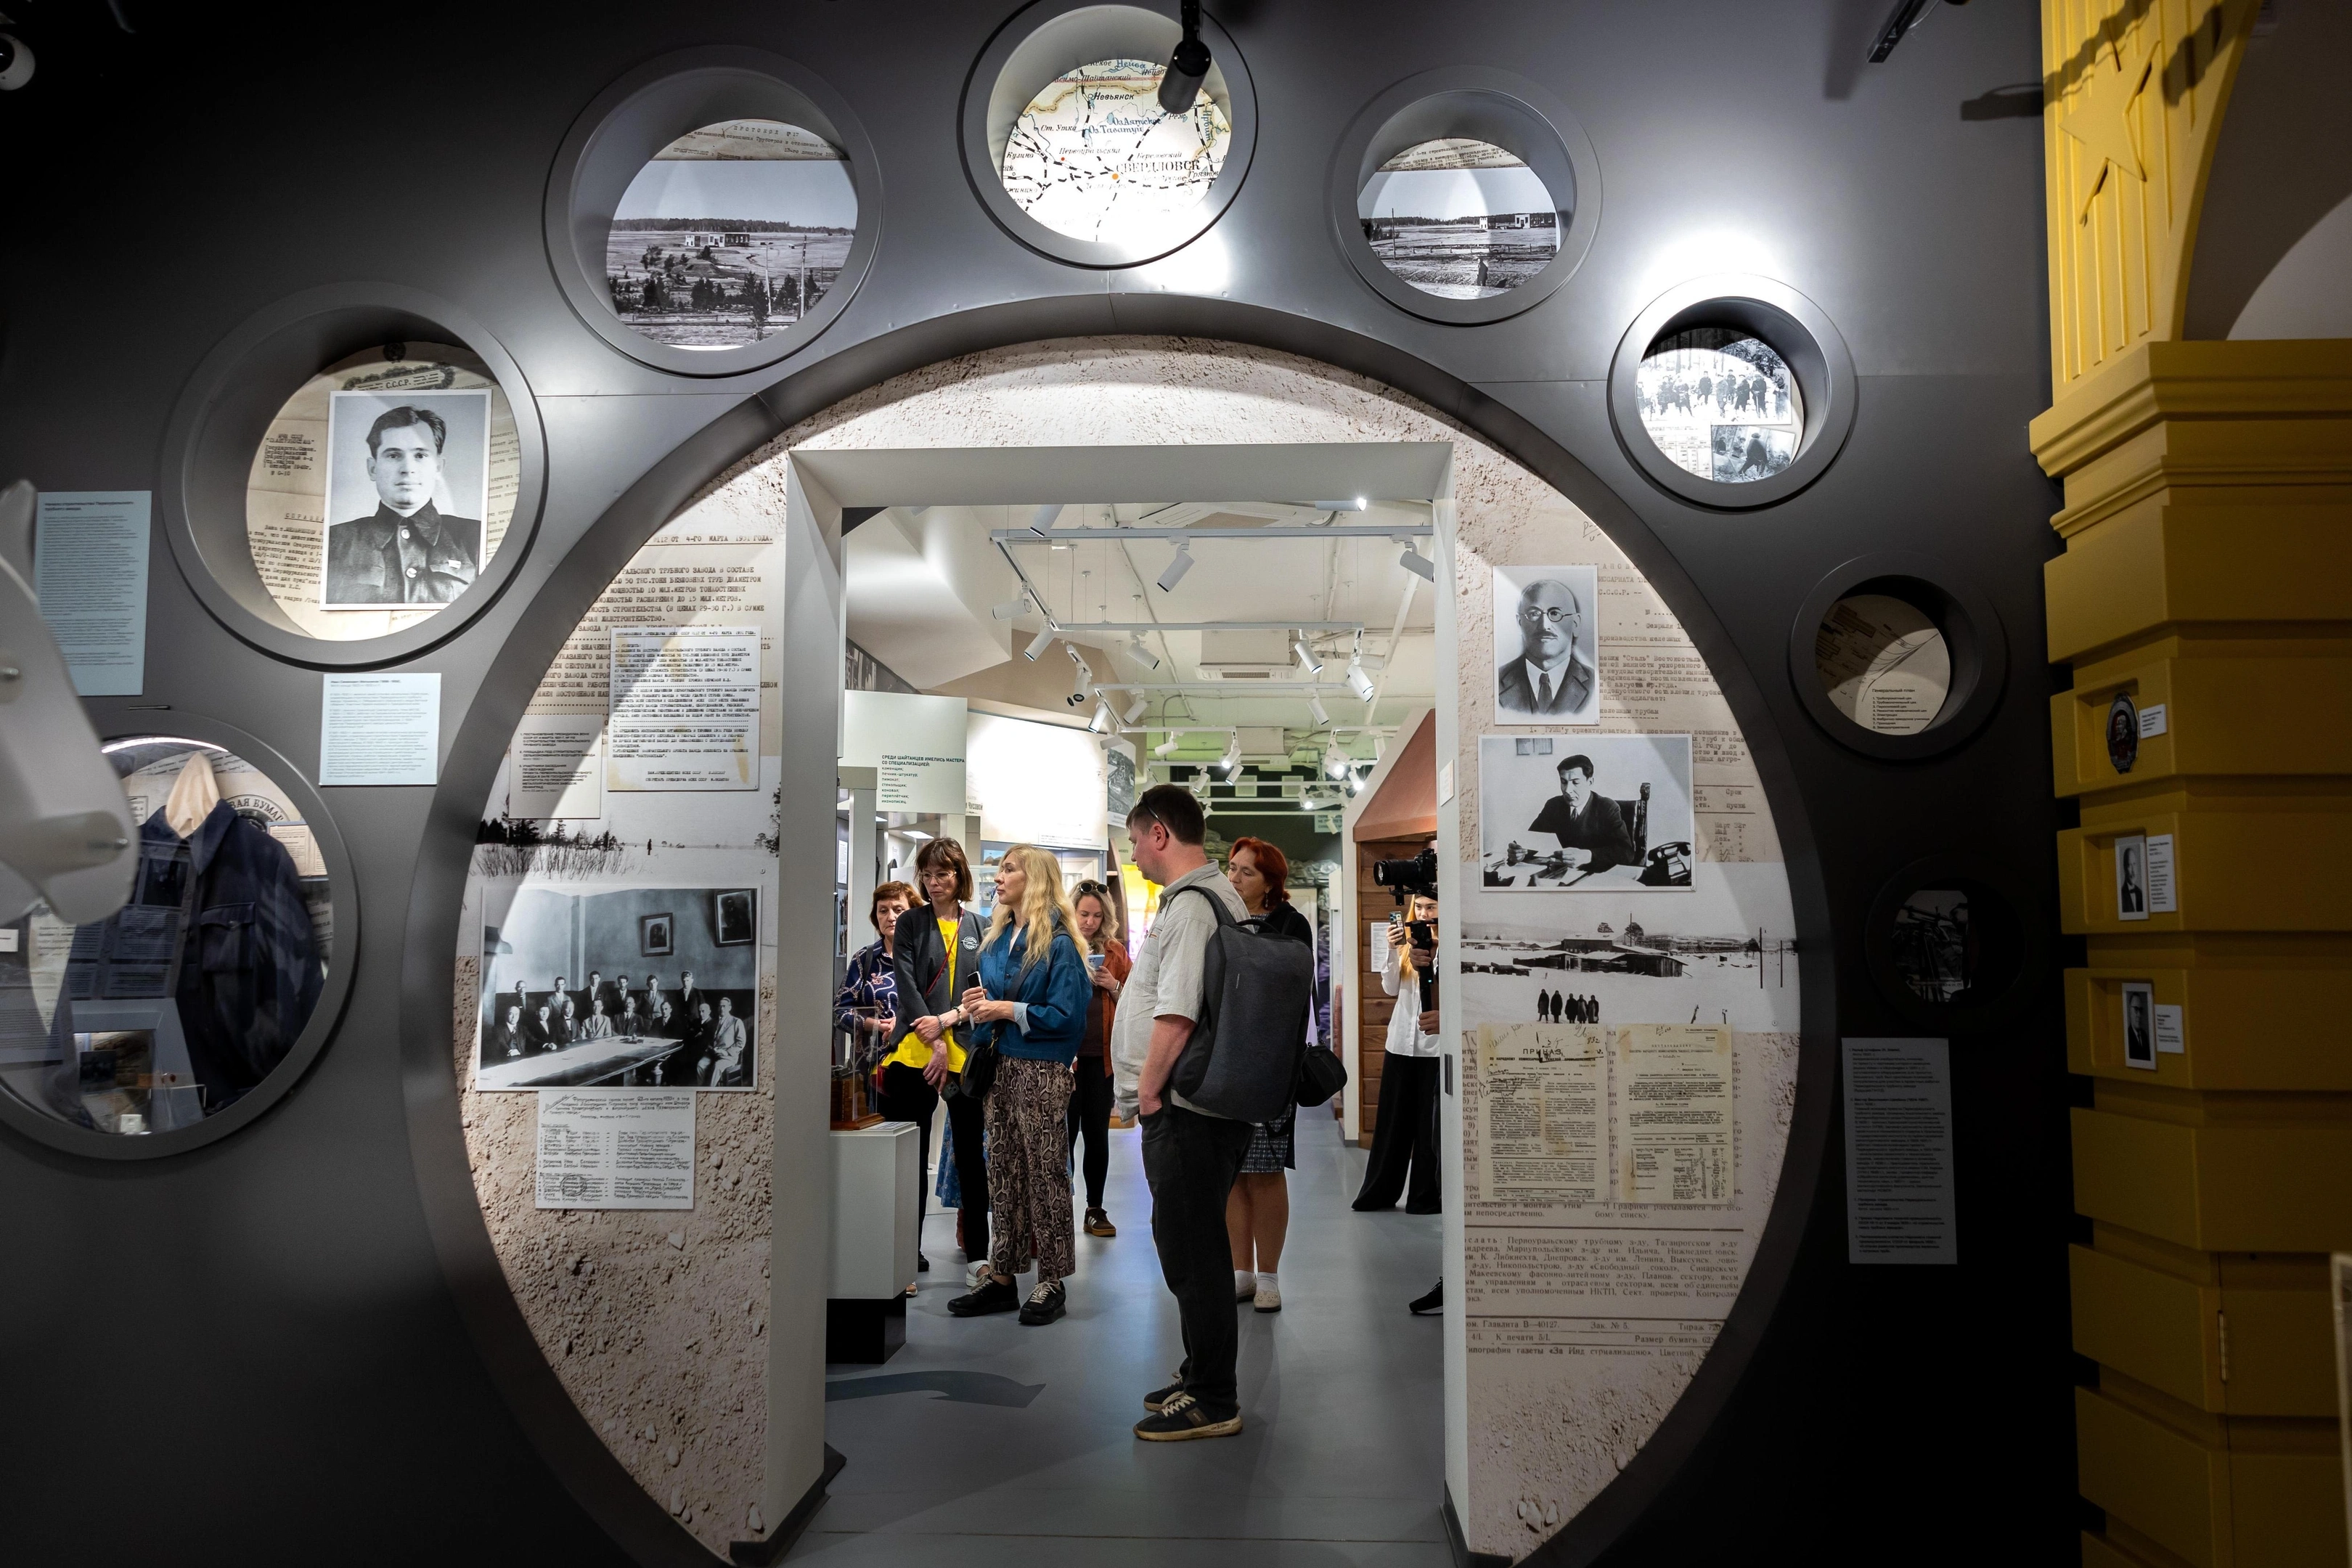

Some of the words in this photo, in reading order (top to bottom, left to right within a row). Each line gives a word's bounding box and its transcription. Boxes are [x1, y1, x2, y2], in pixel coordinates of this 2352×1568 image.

[734, 126, 779, 135] ПРОТОКОЛ
[386, 379, 412, 388] С.С.С.Р.
[1507, 1236, 1578, 1245] Первоуральскому
[1506, 1245, 1575, 1254] Мариупольскому
[1497, 1262, 1562, 1270] Никопольстрою,
[1678, 1323, 1704, 1331] Тираж
[1635, 1334, 1664, 1344] Размер
[1668, 1335, 1697, 1344] бумаги
